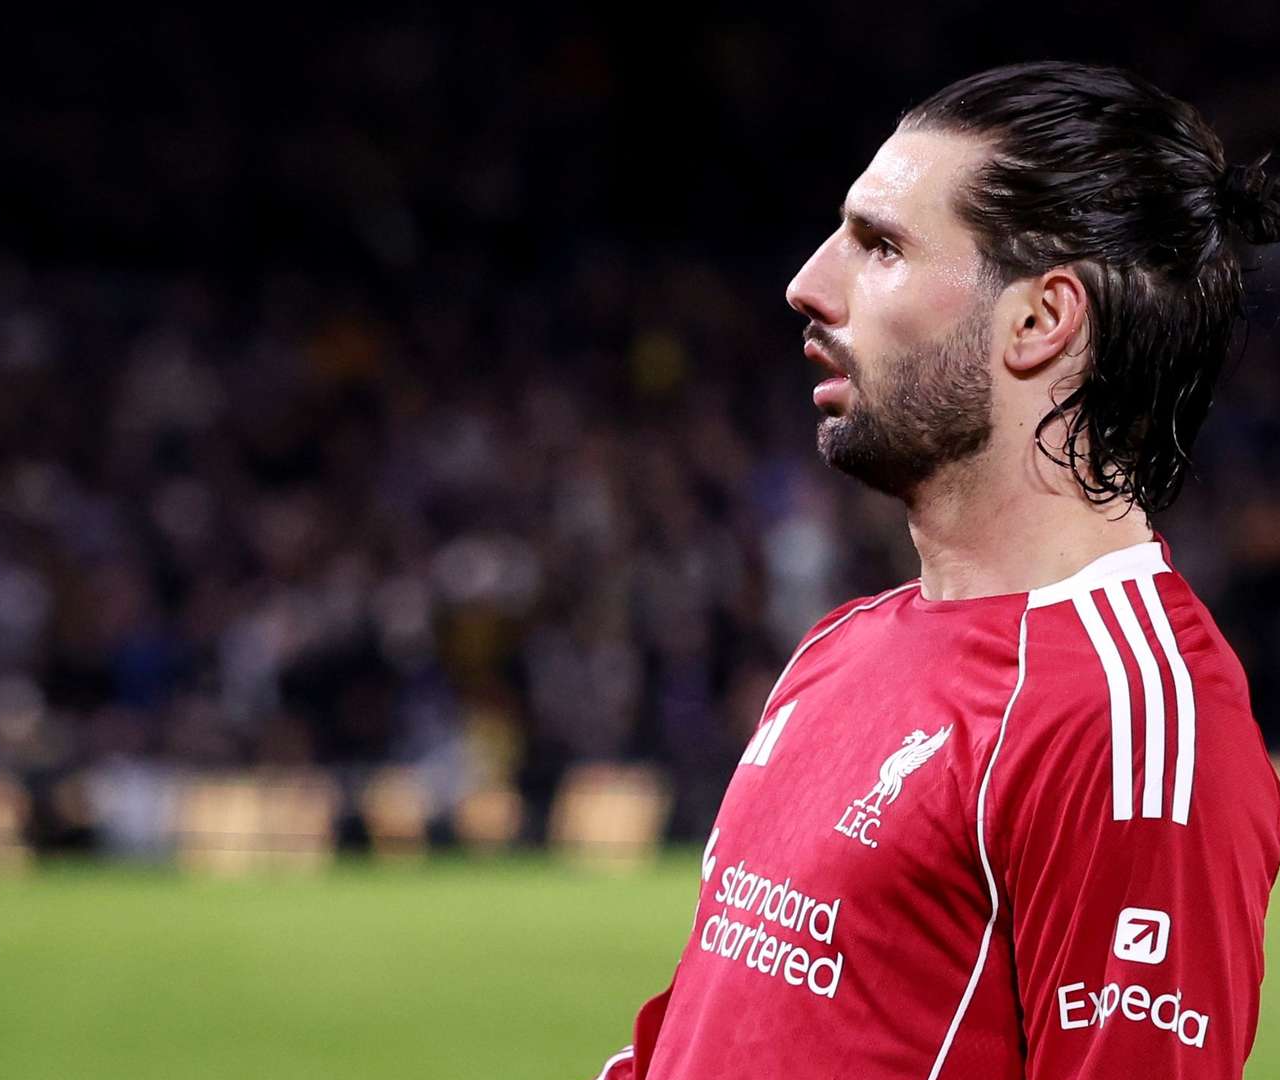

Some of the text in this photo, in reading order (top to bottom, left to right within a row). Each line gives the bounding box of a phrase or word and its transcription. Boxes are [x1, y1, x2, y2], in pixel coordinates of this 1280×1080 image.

[715, 860, 841, 945] standard
[700, 908, 844, 999] chartered
[1057, 981, 1209, 1049] Expeda
